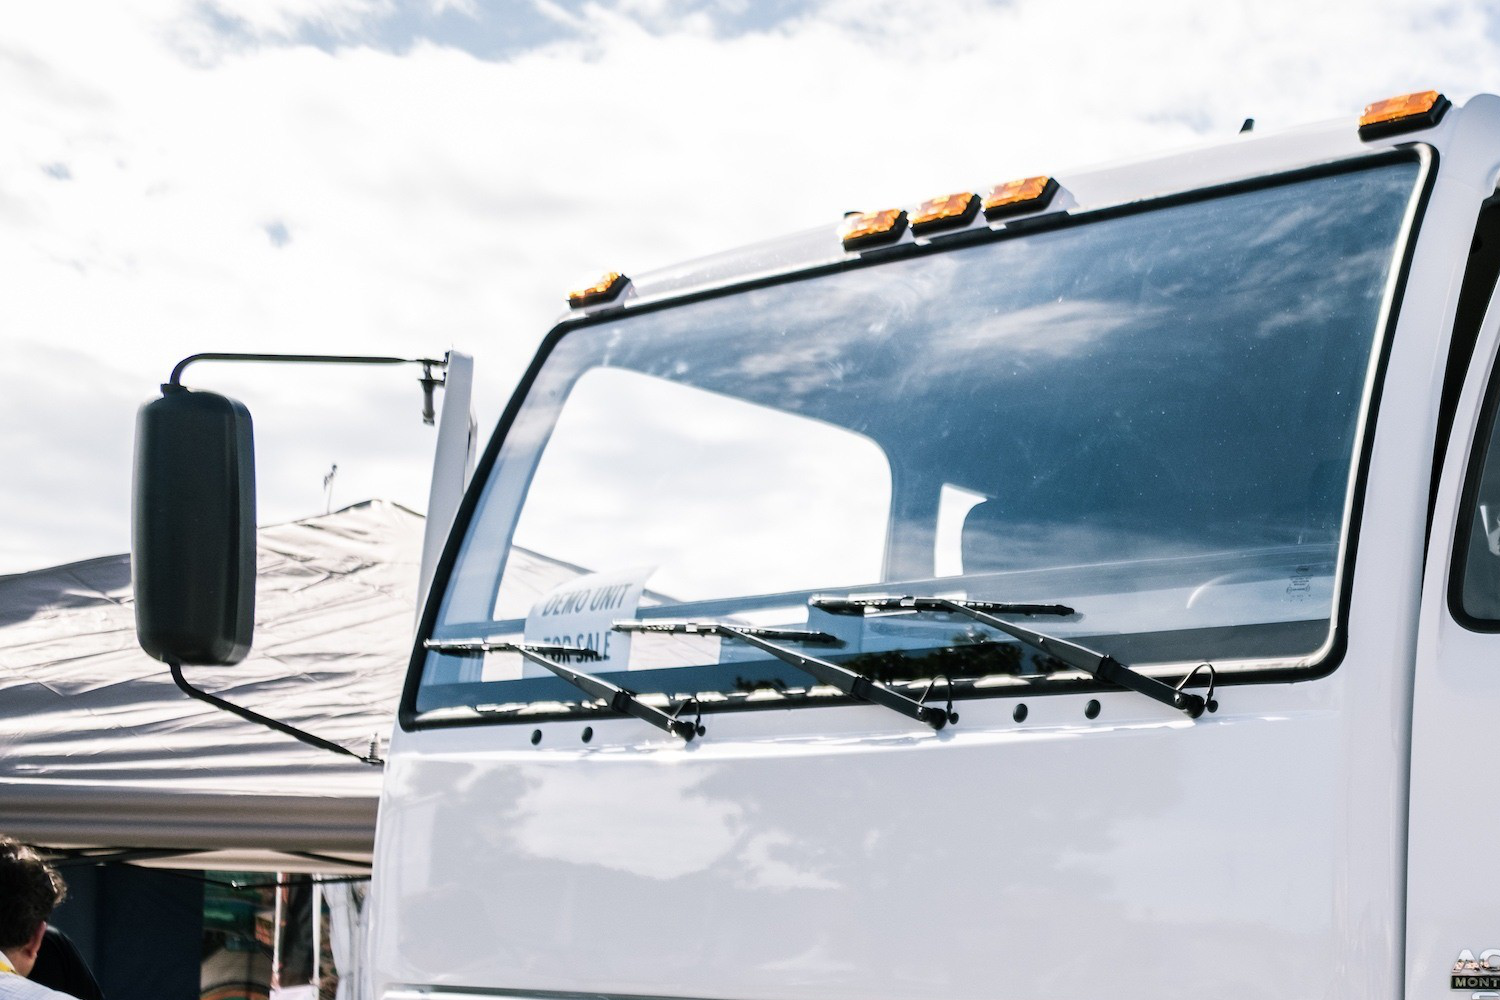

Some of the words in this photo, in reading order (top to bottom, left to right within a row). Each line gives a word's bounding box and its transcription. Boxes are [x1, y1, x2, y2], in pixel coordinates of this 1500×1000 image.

[542, 588, 592, 617] DEMO
[590, 583, 635, 612] UNIT
[576, 631, 612, 663] SALE
